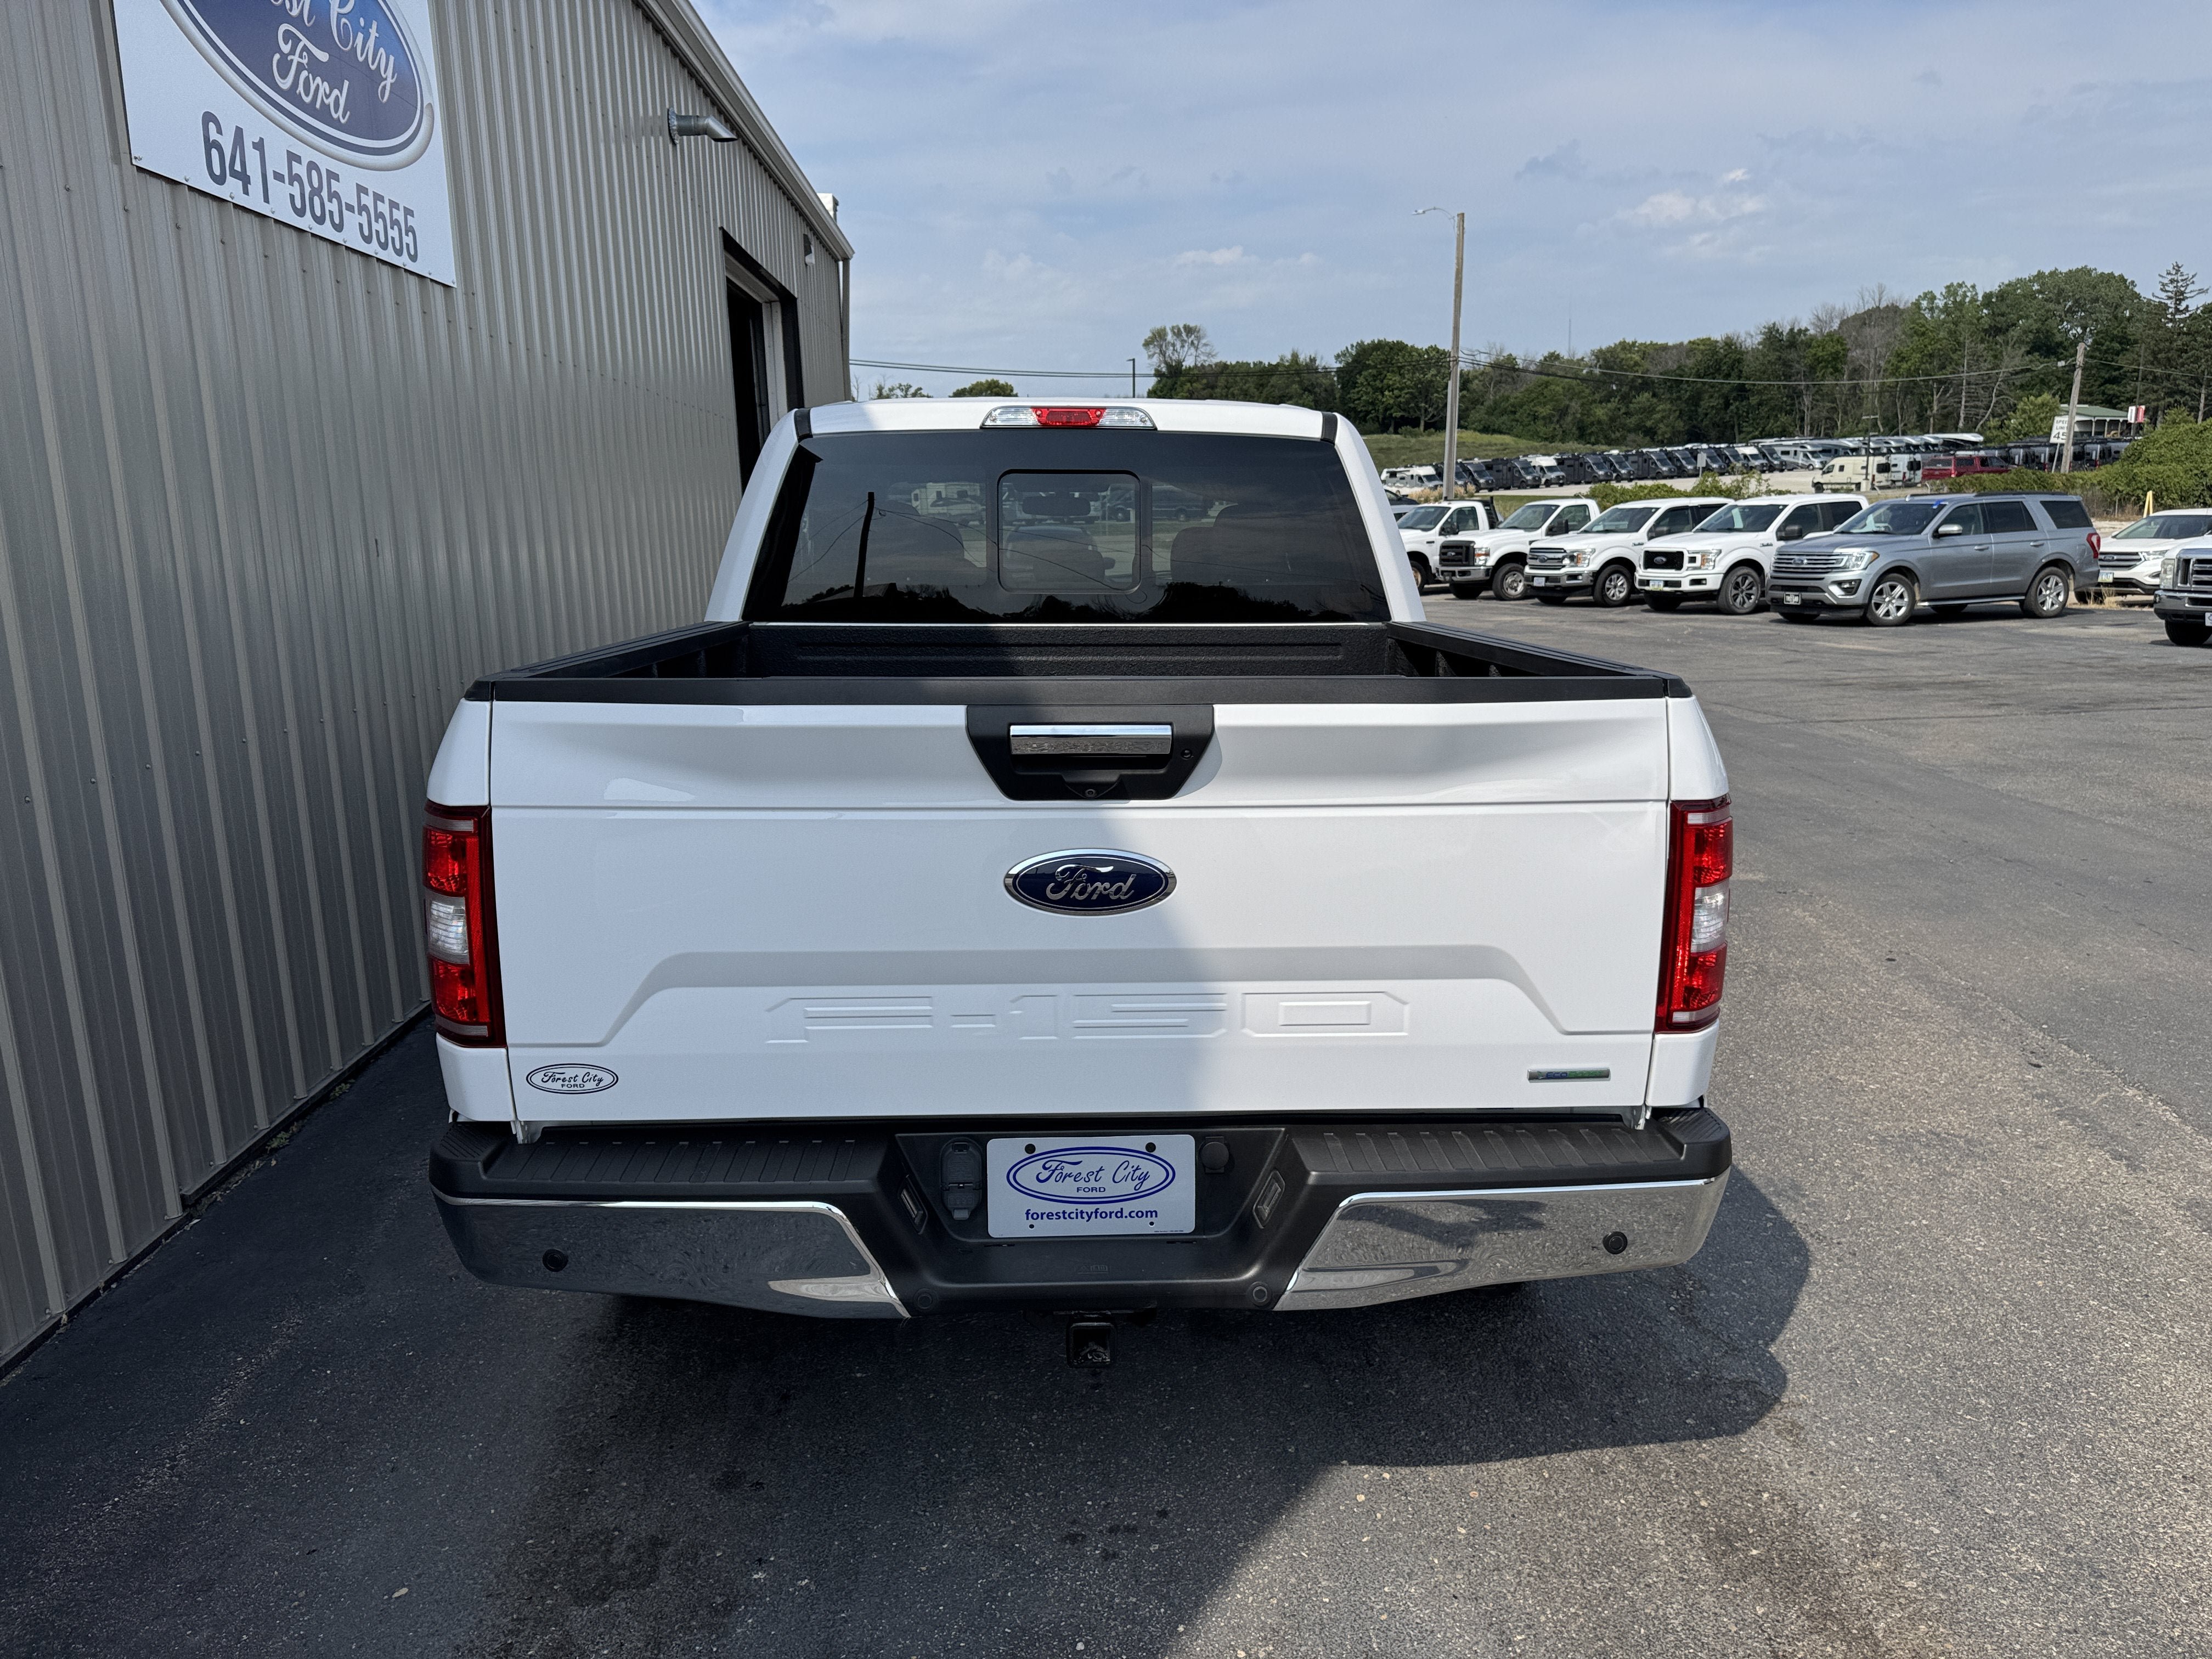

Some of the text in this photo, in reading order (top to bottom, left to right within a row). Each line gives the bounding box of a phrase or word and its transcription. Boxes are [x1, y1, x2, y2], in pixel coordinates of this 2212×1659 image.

[273, 23, 350, 124] Ford
[330, 0, 398, 103] City
[201, 111, 418, 263] 641-585-5555
[1046, 864, 1136, 901] Ford
[766, 990, 1409, 1046] F-150
[541, 1071, 604, 1086] Forest City
[1035, 1159, 1150, 1191] Forest City
[1025, 1207, 1159, 1222] forestcityford.com
